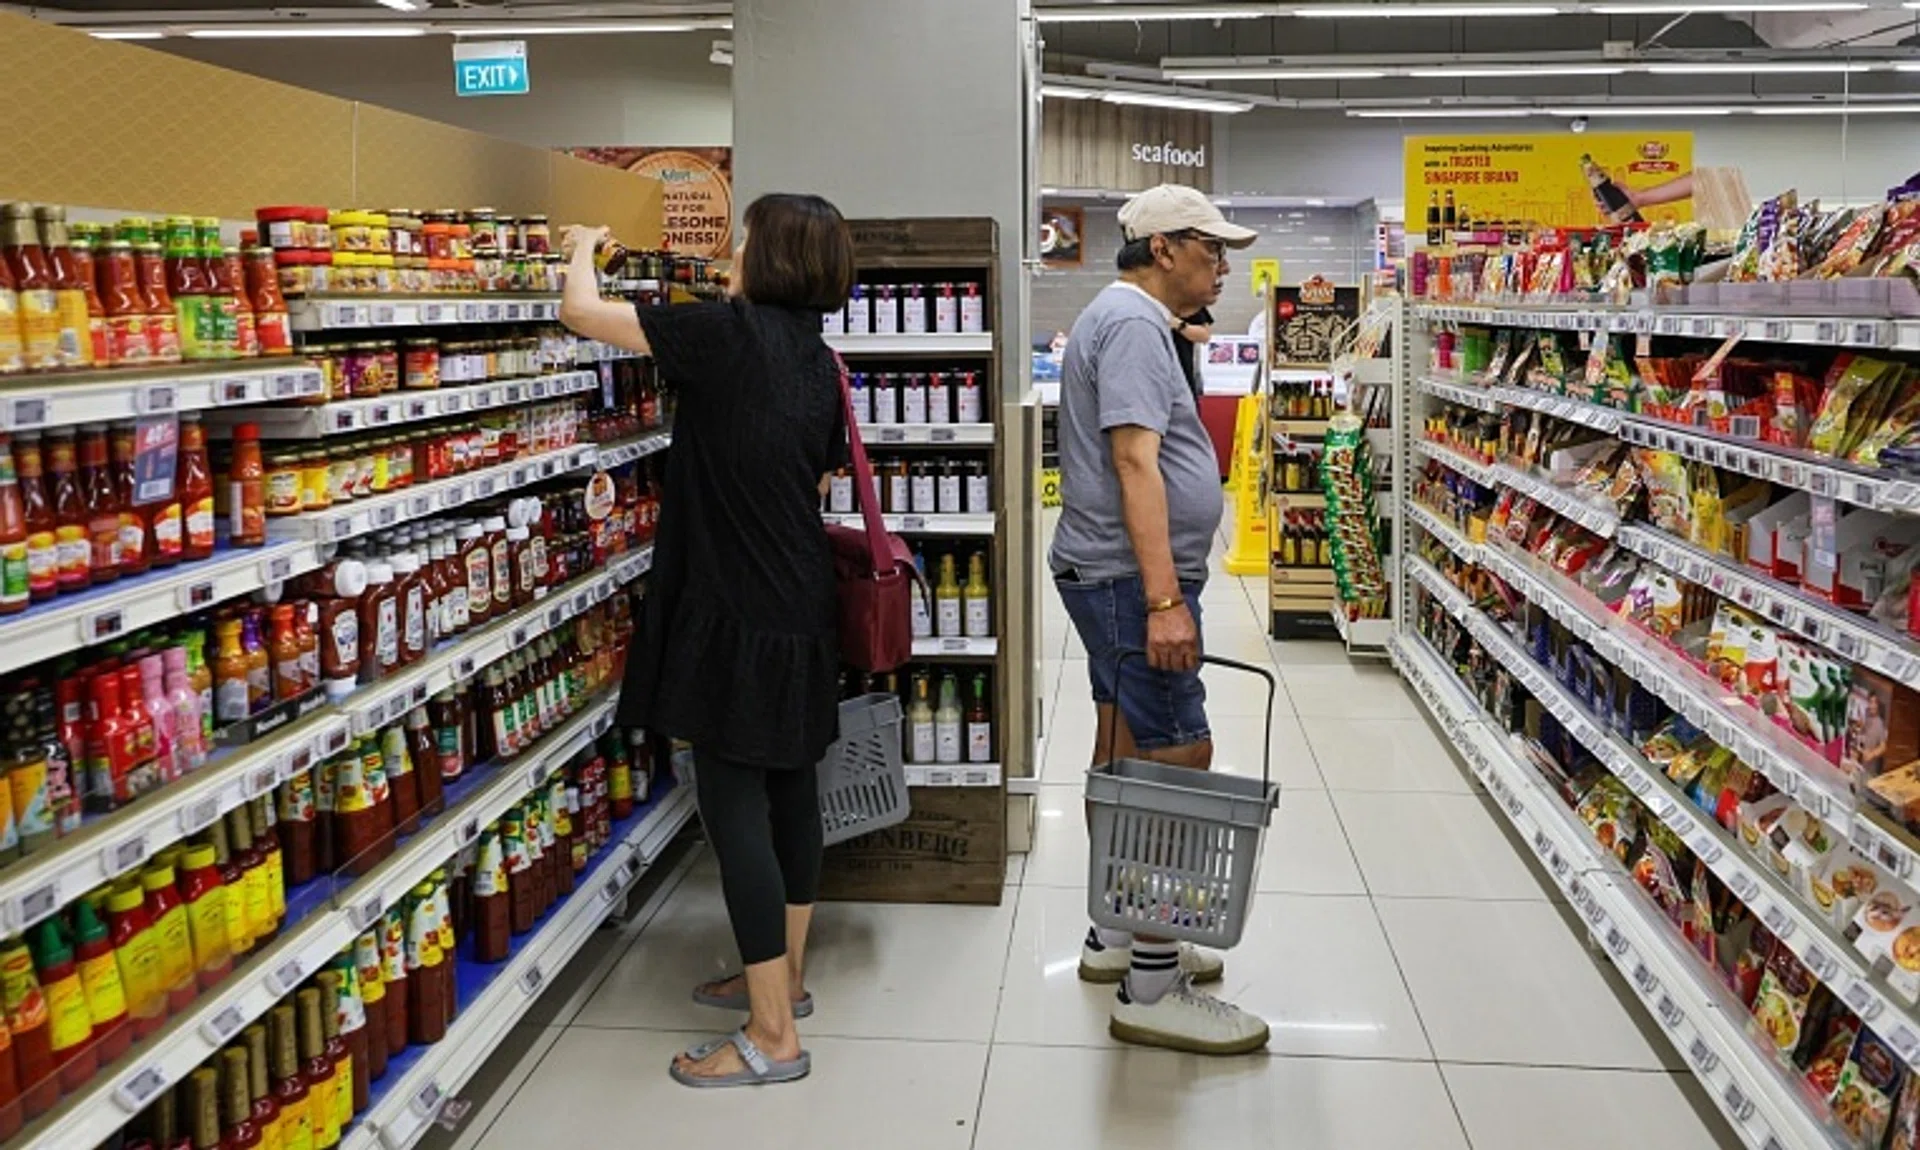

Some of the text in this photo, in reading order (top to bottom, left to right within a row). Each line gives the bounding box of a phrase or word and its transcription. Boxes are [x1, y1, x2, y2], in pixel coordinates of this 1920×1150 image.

[464, 65, 506, 89] EXIT
[1132, 141, 1205, 168] seafood
[1449, 155, 1491, 167] TRUSTED
[1424, 170, 1519, 184] SINGAPORE BRAND
[664, 203, 679, 213] CE
